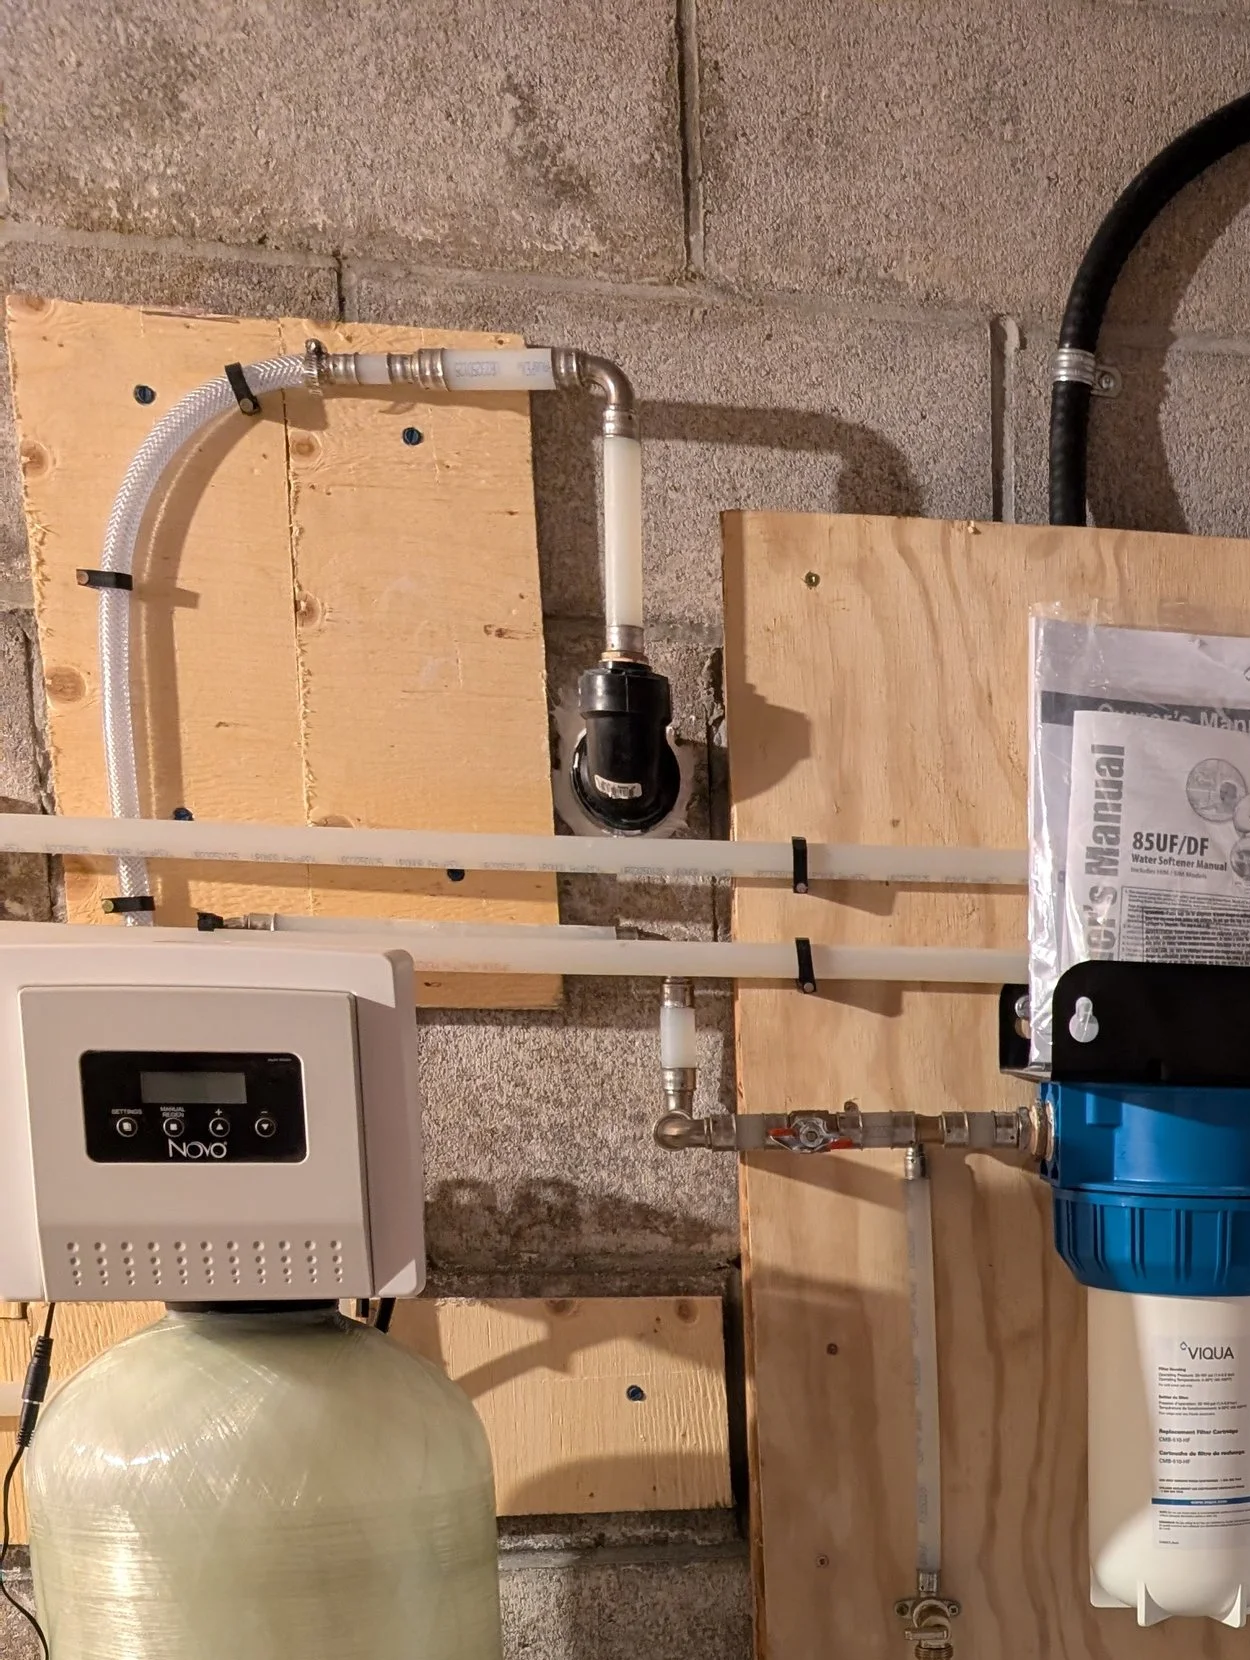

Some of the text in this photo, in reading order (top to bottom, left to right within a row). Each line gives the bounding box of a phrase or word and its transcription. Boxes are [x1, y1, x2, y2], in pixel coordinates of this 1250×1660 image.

[1085, 744, 1126, 878] Manual
[1131, 831, 1209, 857] 85UF/DF
[1131, 853, 1228, 872] Water Softener Manual
[168, 1138, 228, 1159] NOVO
[1187, 1346, 1235, 1360] VIQUA
[1196, 1427, 1211, 1435] Filter
